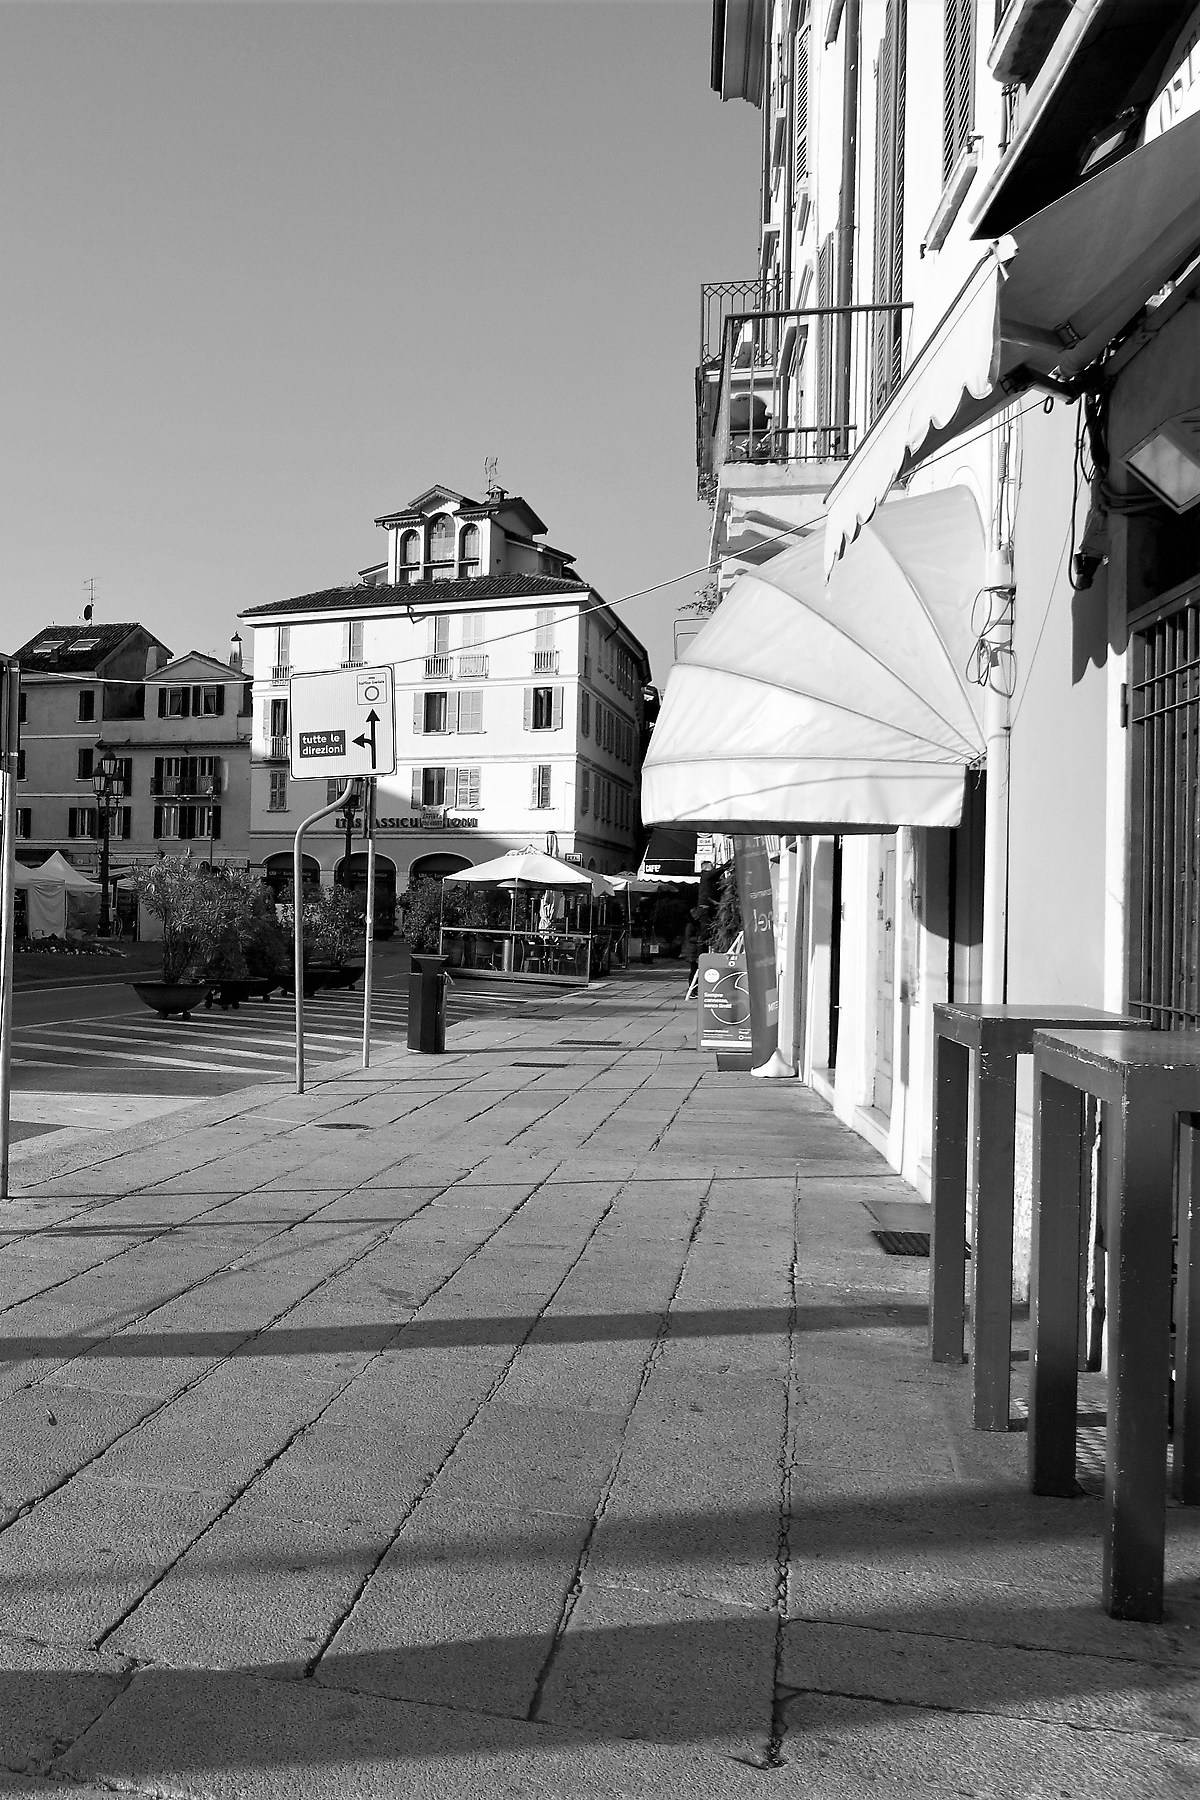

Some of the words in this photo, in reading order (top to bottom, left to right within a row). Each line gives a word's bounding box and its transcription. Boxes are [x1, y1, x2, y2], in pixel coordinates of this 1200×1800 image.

[302, 735, 327, 744] tutte
[330, 733, 340, 742] le
[302, 744, 343, 755] direzioni
[335, 818, 362, 828] ITS
